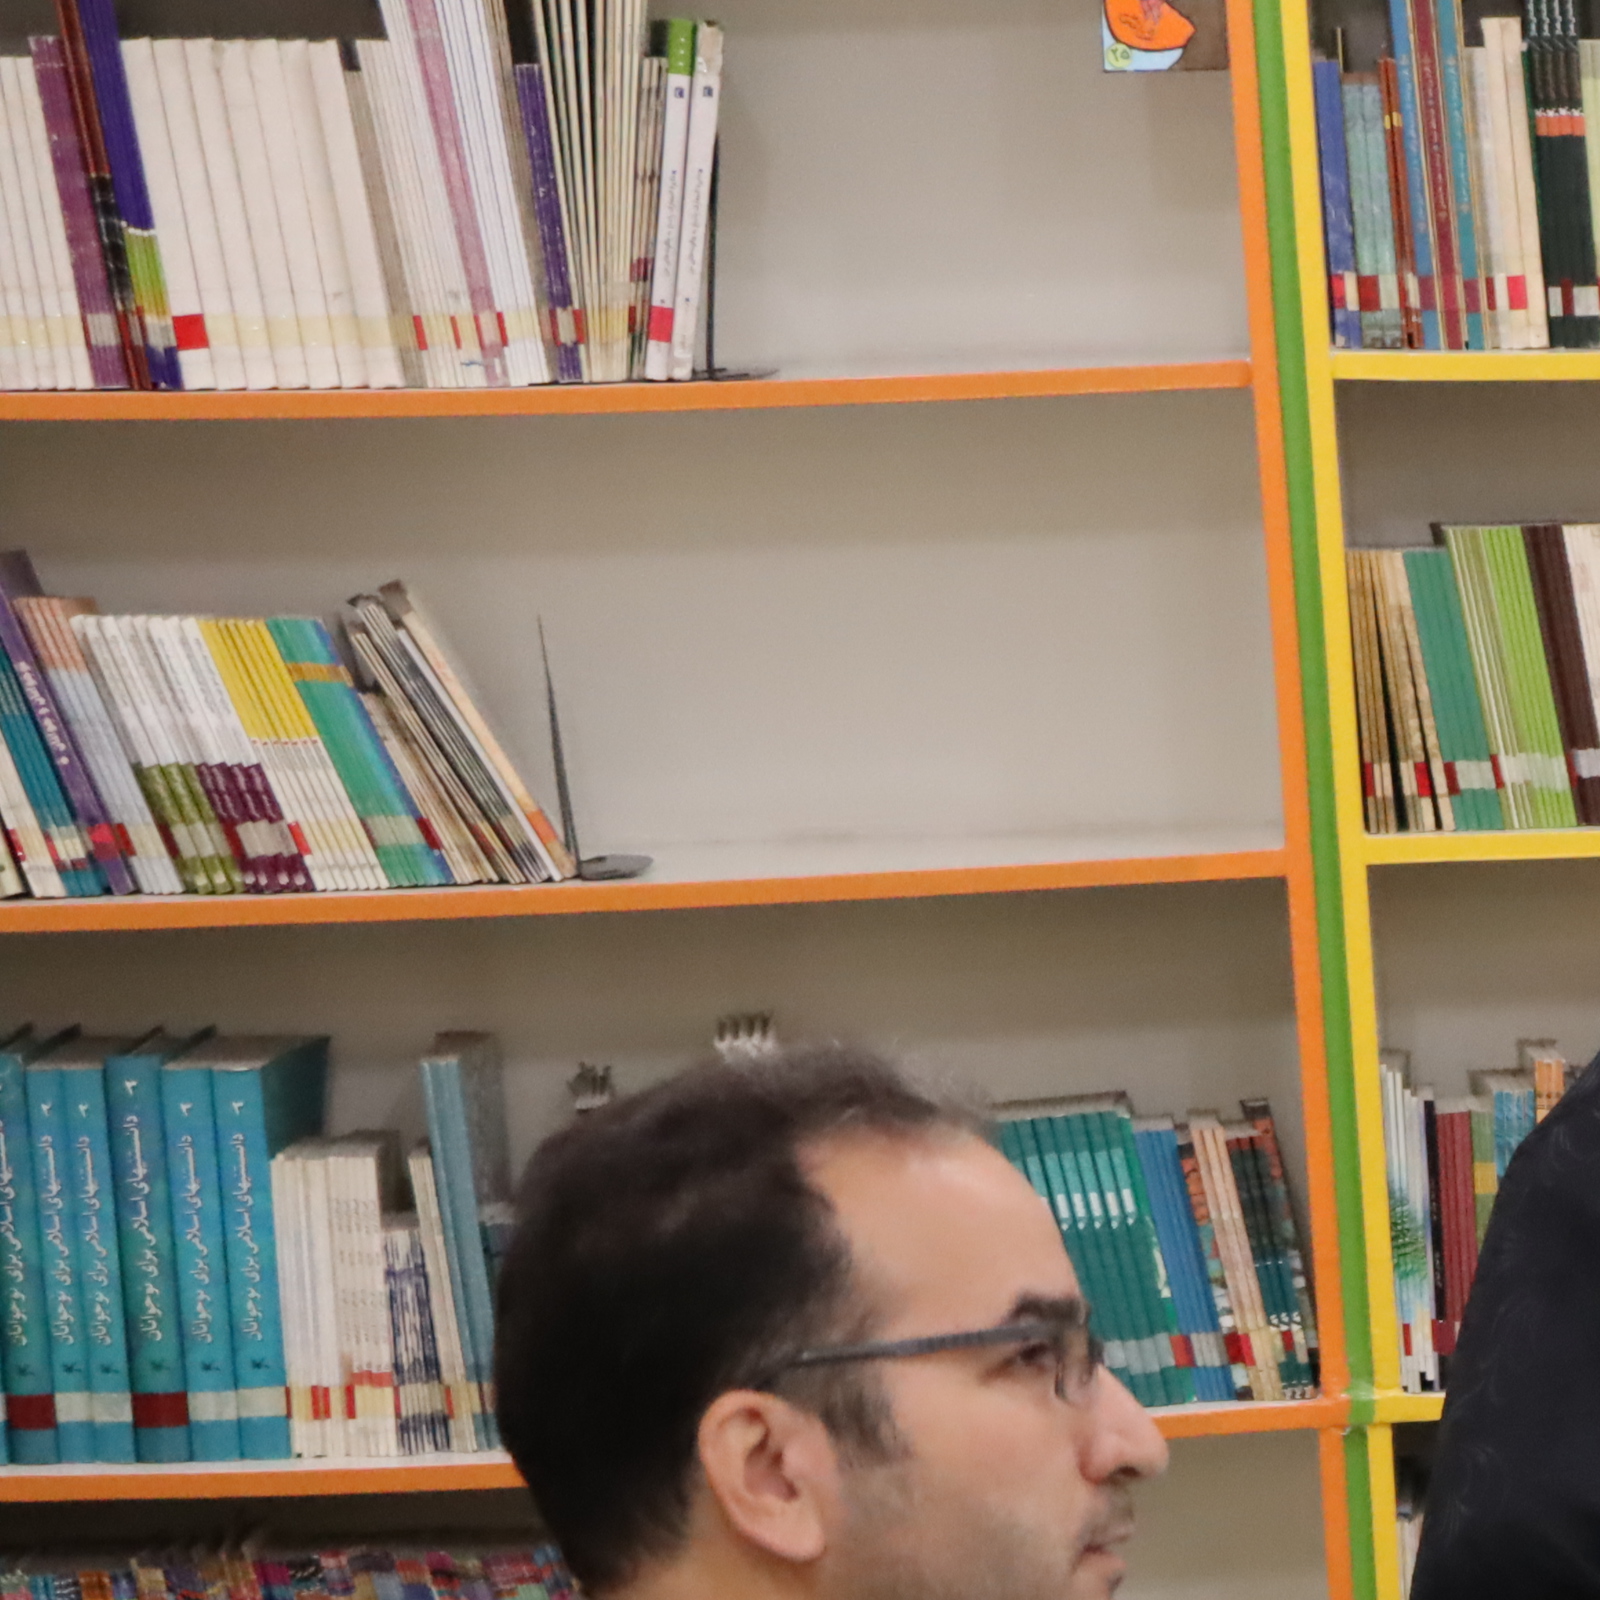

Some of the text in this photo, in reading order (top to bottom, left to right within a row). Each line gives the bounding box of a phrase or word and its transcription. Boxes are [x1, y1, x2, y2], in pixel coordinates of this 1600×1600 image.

[44, 1209, 69, 1257] اسلامی
[82, 1211, 107, 1258] اسلامی
[129, 1196, 156, 1246] اسلامی
[185, 1210, 208, 1257] اسلامی
[235, 1207, 259, 1254] اسلامی
[4, 1254, 24, 1282] برای
[52, 1259, 71, 1286] برای
[87, 1260, 108, 1287] برای
[136, 1248, 159, 1277] برای
[189, 1258, 209, 1285] برای
[240, 1256, 261, 1283] برای
[7, 1287, 28, 1346] نوجوانان
[53, 1290, 75, 1345] نوجوانان
[90, 1291, 112, 1345] نوجوانان
[139, 1282, 162, 1341] نوجوانان
[191, 1289, 213, 1343] نوجوانان
[242, 1287, 263, 1341] نوجوانان
